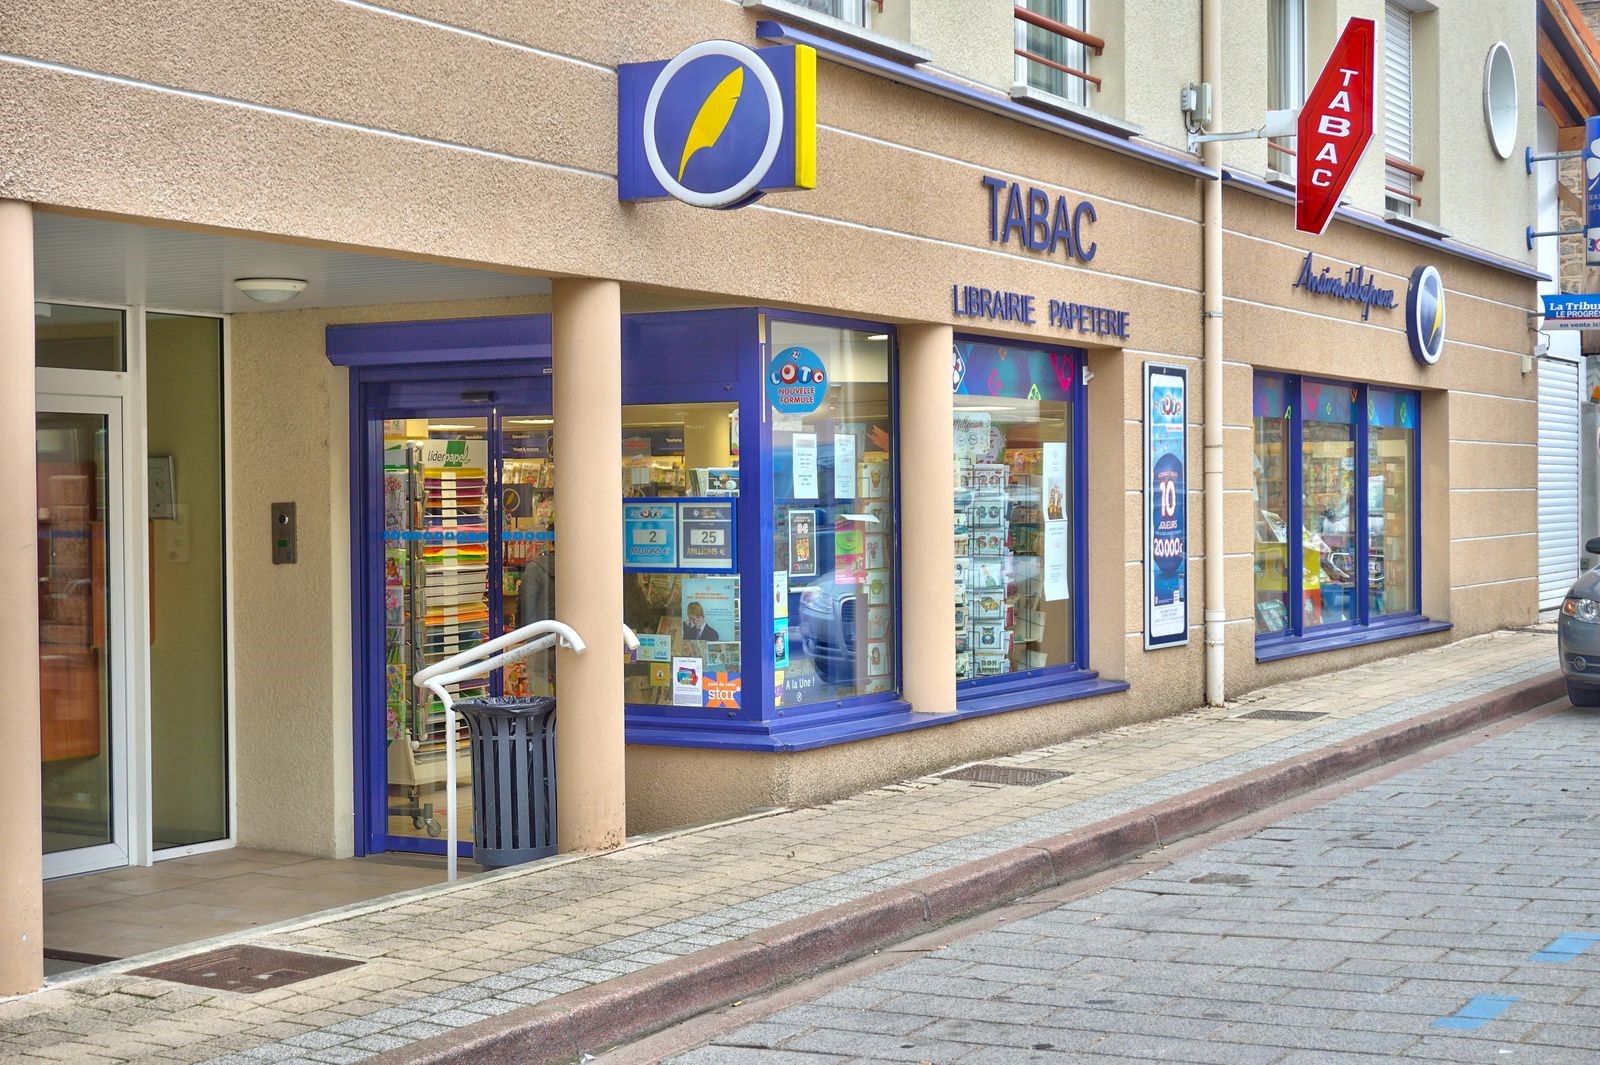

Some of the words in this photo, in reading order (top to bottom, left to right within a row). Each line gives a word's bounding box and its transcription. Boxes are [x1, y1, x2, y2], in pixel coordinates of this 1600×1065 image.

[1311, 68, 1359, 187] TABAC
[982, 175, 1097, 262] TABAC
[953, 284, 1036, 325] LIBRAIRIE
[1049, 299, 1130, 338] PAPETERIE
[1550, 303, 1563, 311] La
[770, 362, 824, 385] LOTO
[778, 387, 815, 395] NOUVELLE
[780, 396, 814, 405] FORMULE
[1158, 479, 1176, 517] 10
[649, 531, 657, 543] 2
[701, 531, 717, 544] 25
[631, 547, 661, 555] MILLIONS
[686, 547, 718, 556] MILLIONS
[785, 680, 791, 690] A
[792, 679, 798, 689] la
[799, 678, 811, 688] Une
[708, 686, 735, 700] star
